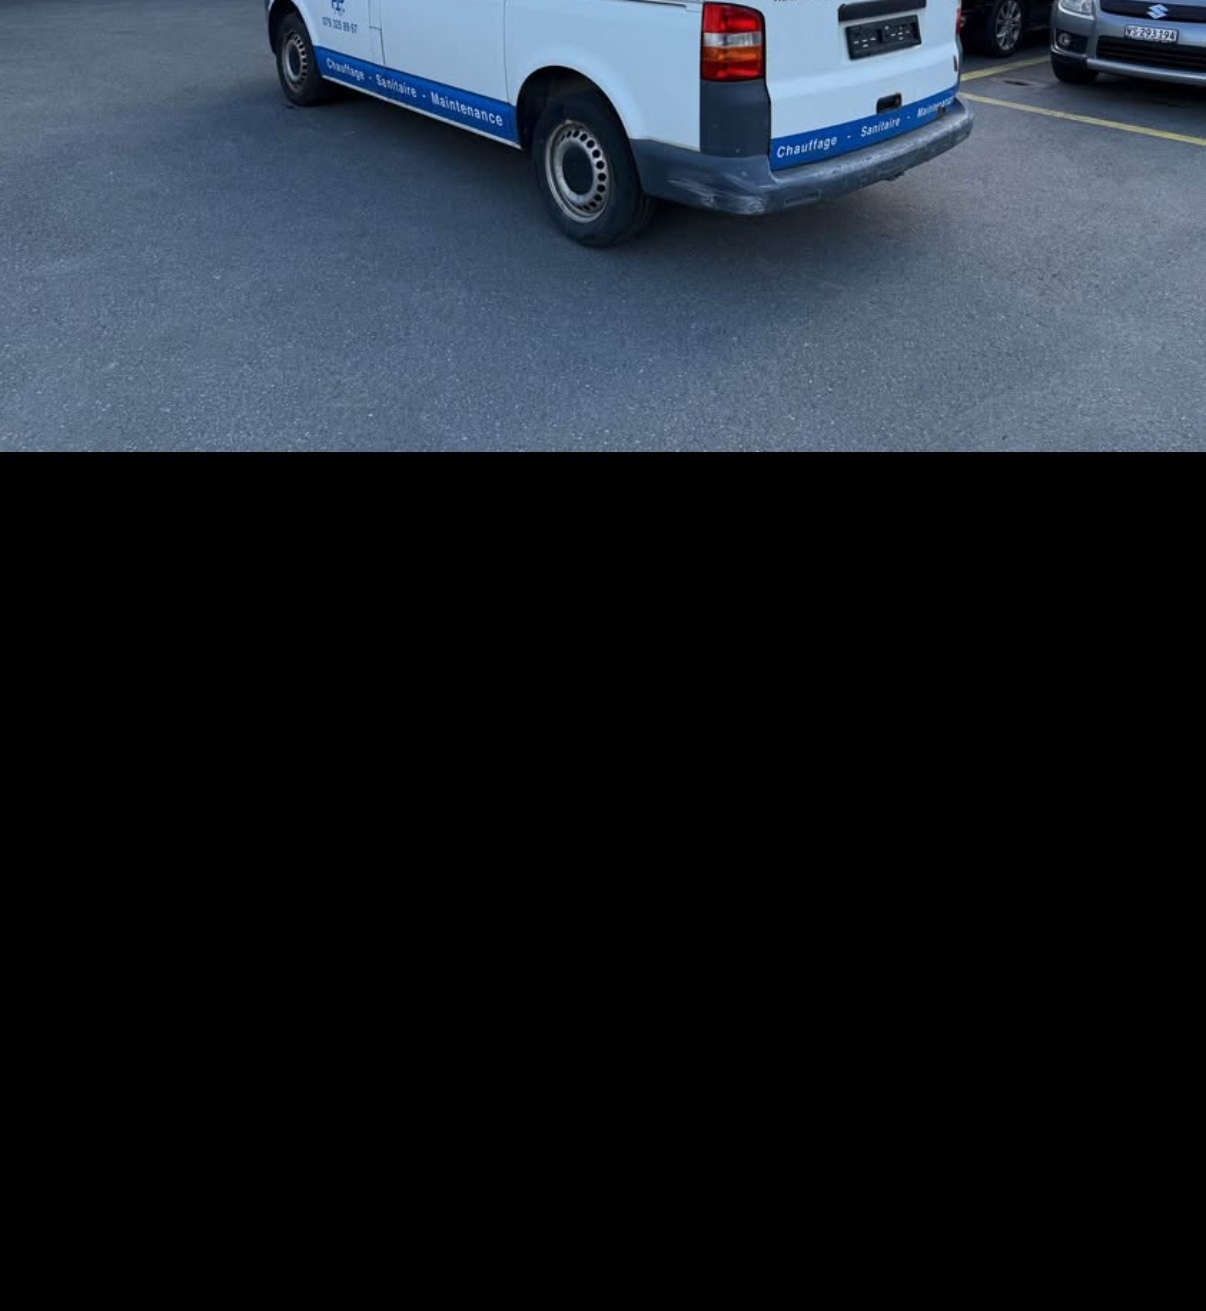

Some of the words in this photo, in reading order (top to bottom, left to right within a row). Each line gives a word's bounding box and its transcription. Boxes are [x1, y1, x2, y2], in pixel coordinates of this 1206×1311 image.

[325, 57, 365, 81] Chauffage
[375, 73, 418, 98] Sanitaire
[430, 92, 504, 127] Maintenance
[776, 134, 838, 159] Chauffage
[860, 117, 901, 138] Sanitaire
